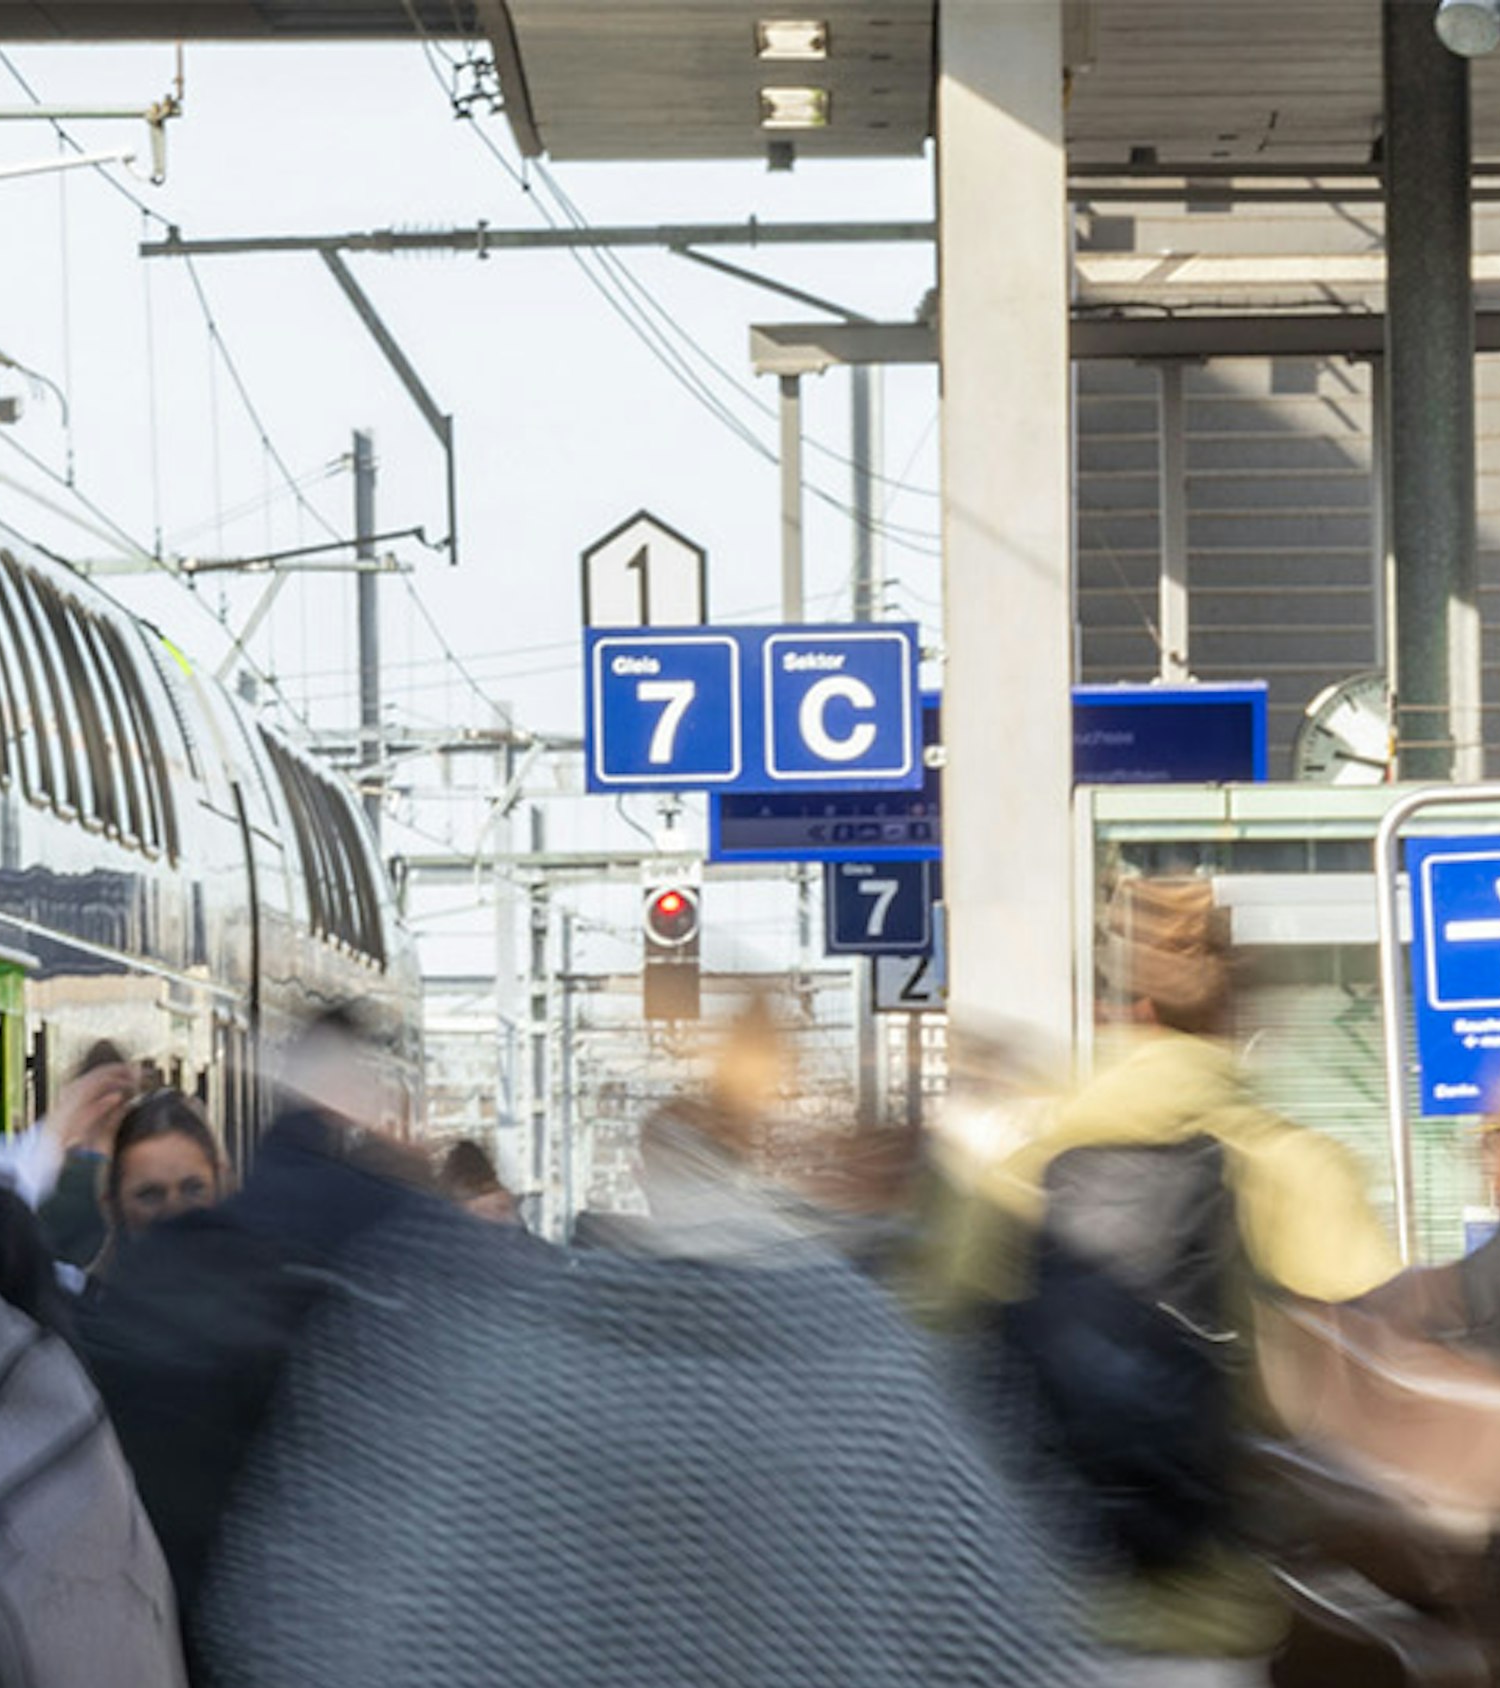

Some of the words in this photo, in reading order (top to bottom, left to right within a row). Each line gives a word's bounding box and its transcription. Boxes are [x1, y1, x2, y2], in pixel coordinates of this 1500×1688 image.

[625, 542, 649, 627] 1
[611, 655, 661, 676] Gleis
[782, 651, 846, 673] Sektor
[636, 679, 696, 765] 7
[798, 674, 877, 763] C
[858, 878, 899, 937] 7
